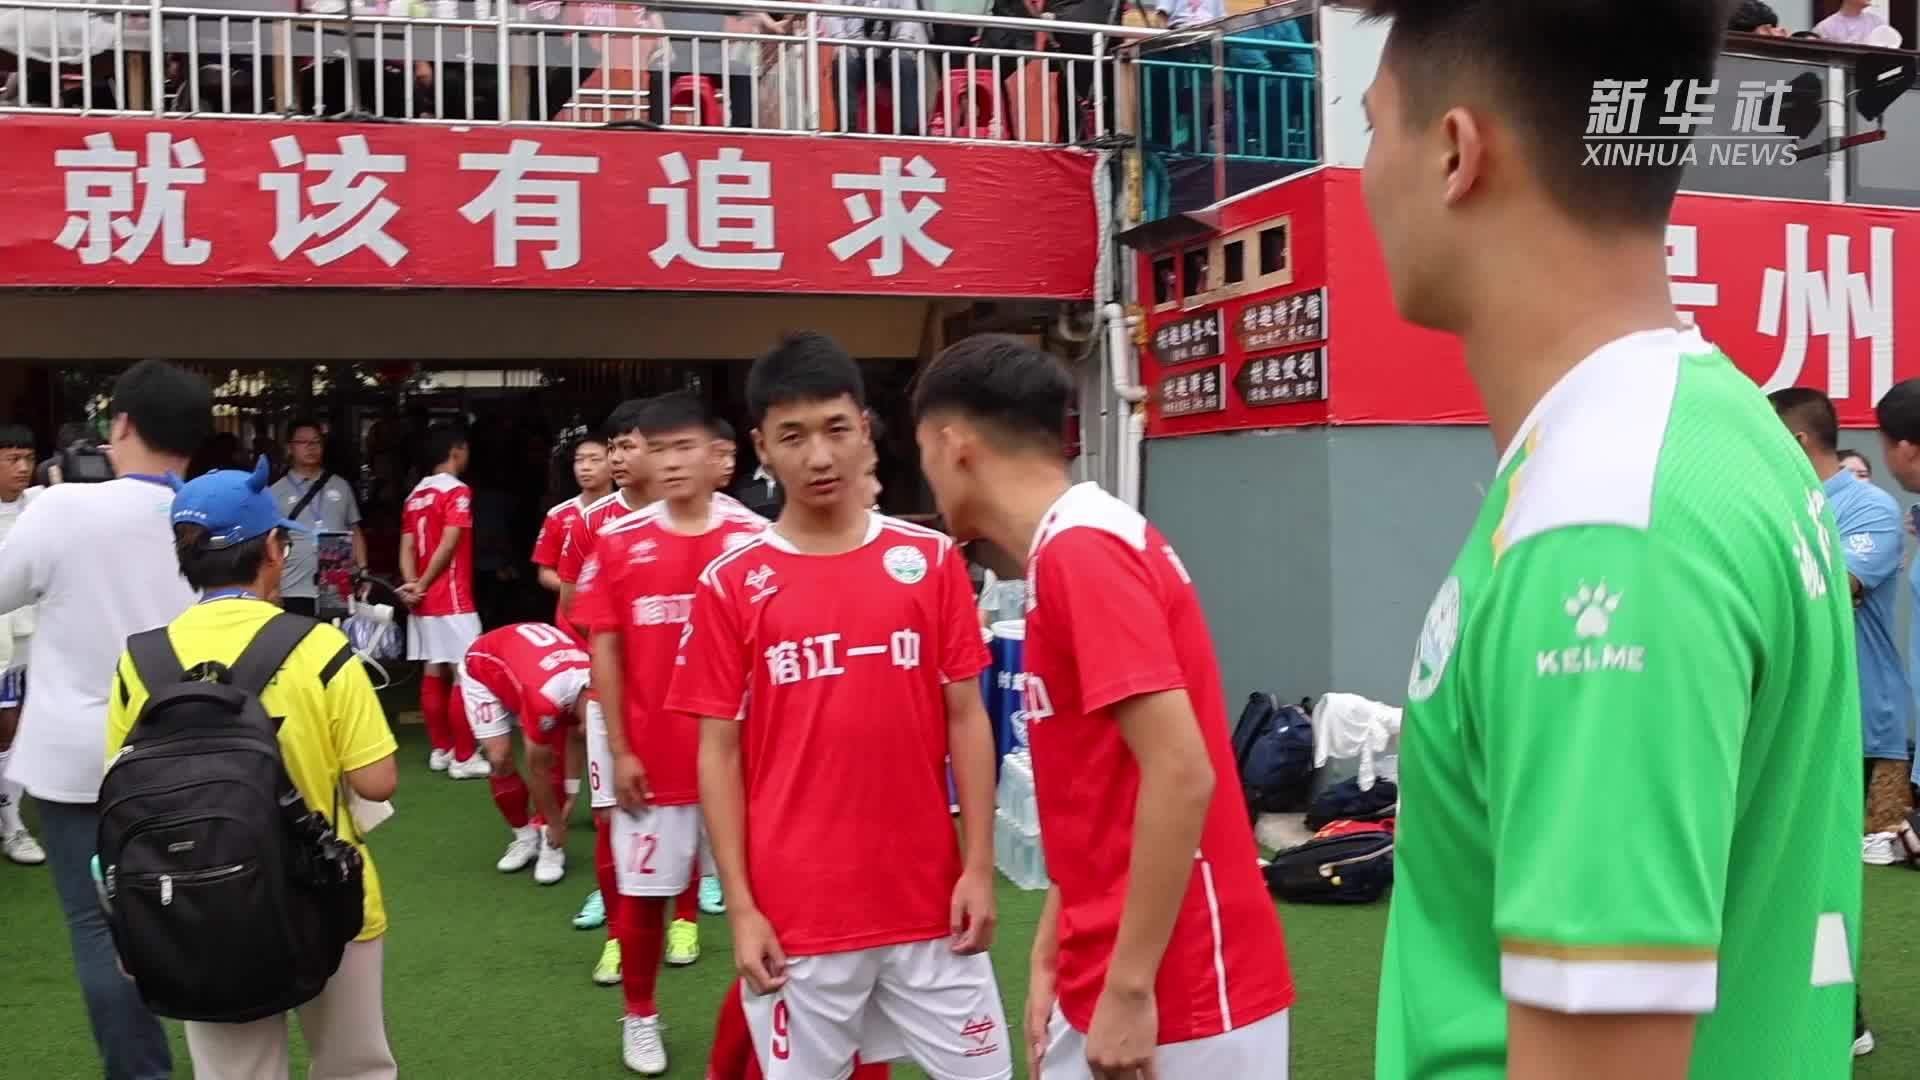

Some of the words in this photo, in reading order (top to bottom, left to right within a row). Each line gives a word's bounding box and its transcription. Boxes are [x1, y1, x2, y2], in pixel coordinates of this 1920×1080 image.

[54, 131, 954, 277] 就该有追求
[763, 628, 922, 687] 榕江一中
[1536, 642, 1647, 677] KELME
[626, 832, 658, 875] 12
[771, 998, 791, 1061] 9
